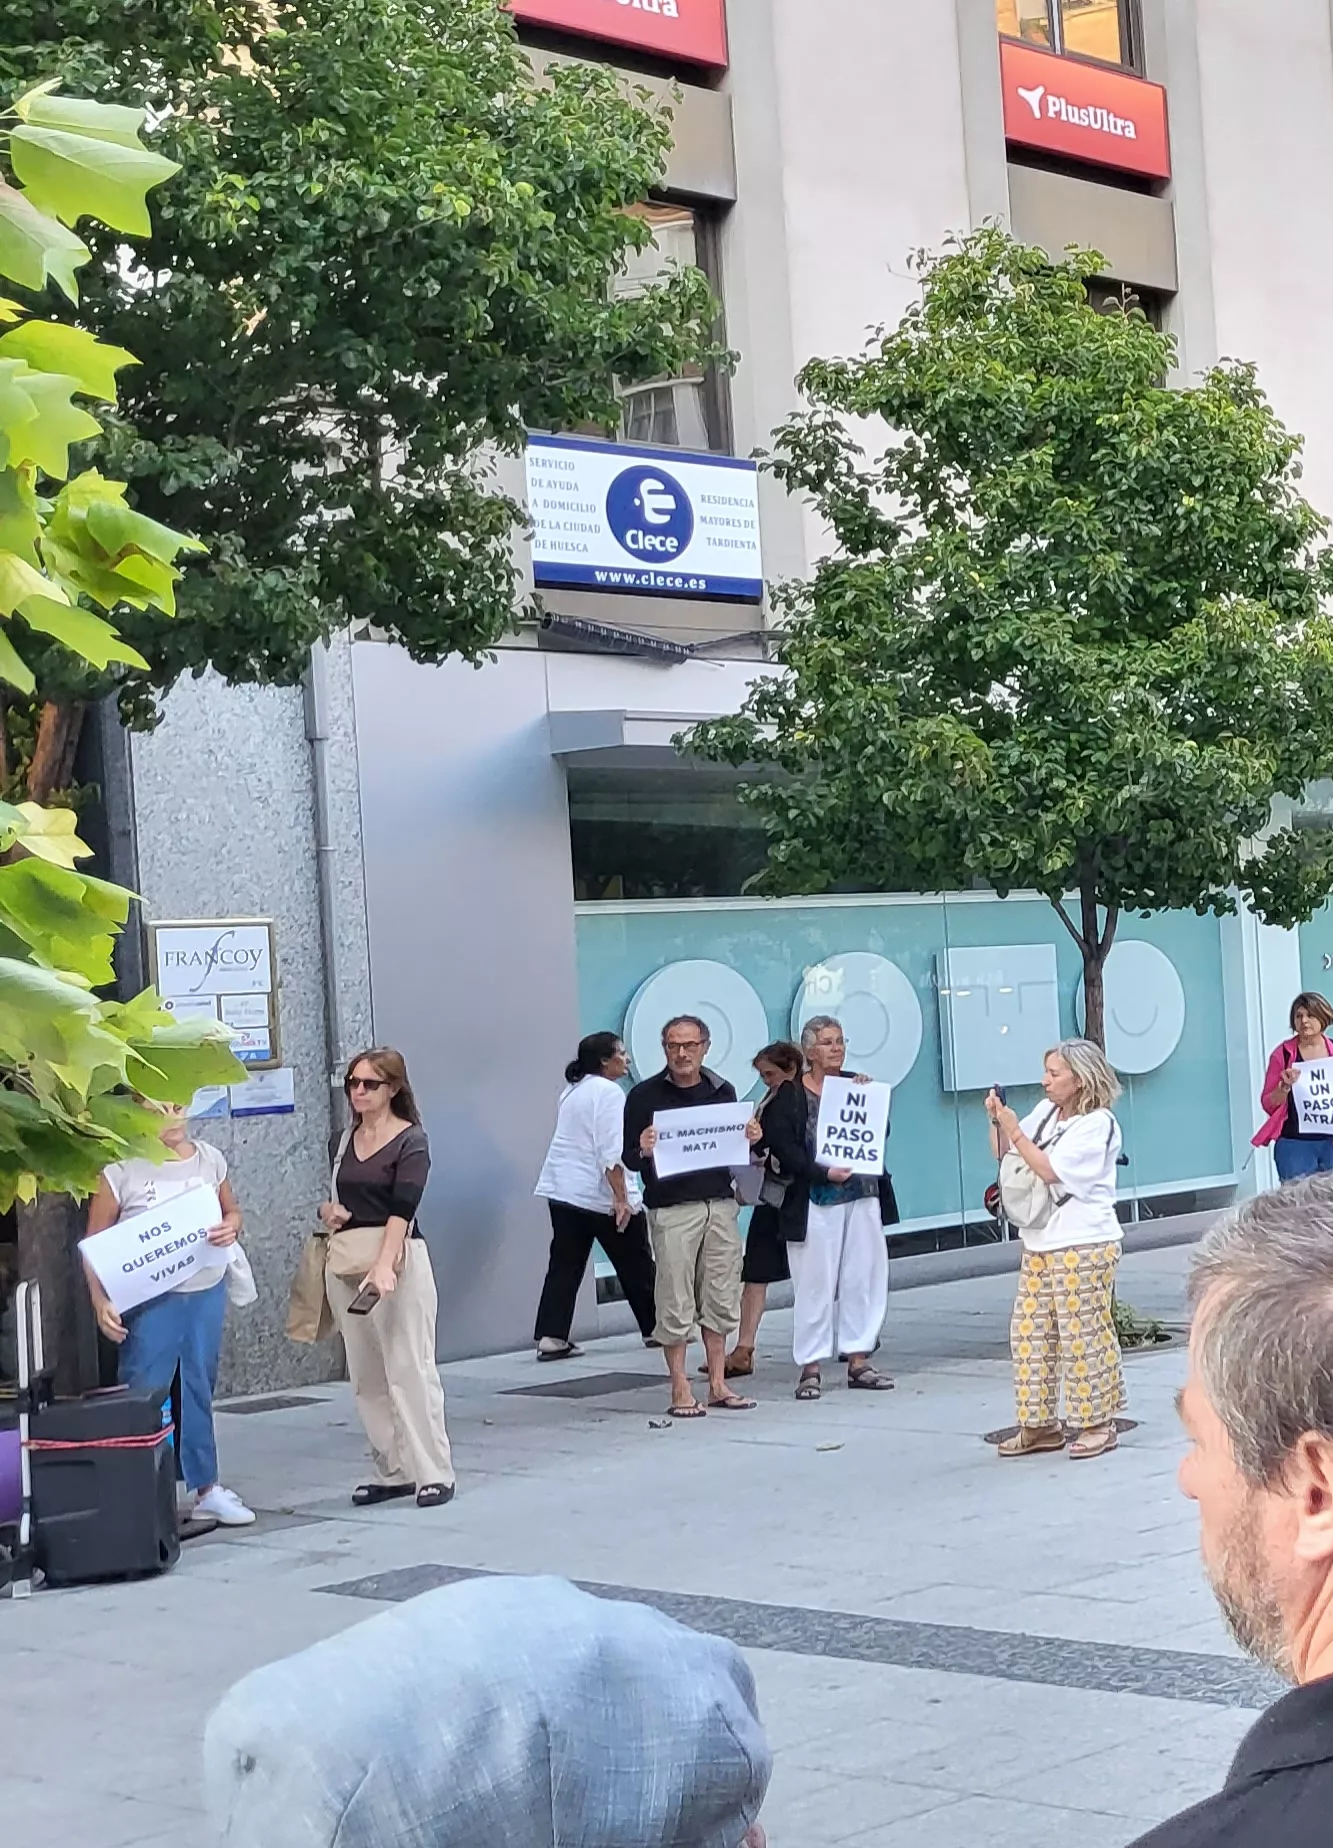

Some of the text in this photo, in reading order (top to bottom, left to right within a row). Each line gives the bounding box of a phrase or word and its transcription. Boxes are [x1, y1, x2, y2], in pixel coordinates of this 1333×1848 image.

[1046, 94, 1136, 139] PlusUltra
[529, 457, 575, 471] SERVICIO
[531, 477, 579, 492] DE AYUDA
[532, 499, 596, 513] A DOMICILIO
[700, 494, 755, 508] RESIDENCIA
[549, 520, 562, 531] LA
[563, 521, 601, 534] CIUDAD
[700, 515, 756, 529] MAYORES DE
[535, 539, 589, 553] DE HUESCA
[625, 529, 679, 552] Clece
[706, 537, 757, 550] TARDIENTA
[594, 569, 707, 590] www.clece.es
[1310, 1068, 1326, 1082] NI
[1309, 1084, 1331, 1096] UN
[846, 1091, 866, 1108] NI
[839, 1109, 867, 1125] UN
[659, 1123, 745, 1141] EL MACHISMO
[826, 1126, 875, 1143] PASO
[682, 1141, 717, 1153] MATA
[821, 1143, 878, 1162] ATRÁS
[138, 1221, 172, 1244] NOS
[121, 1227, 208, 1273] QUEREMOS
